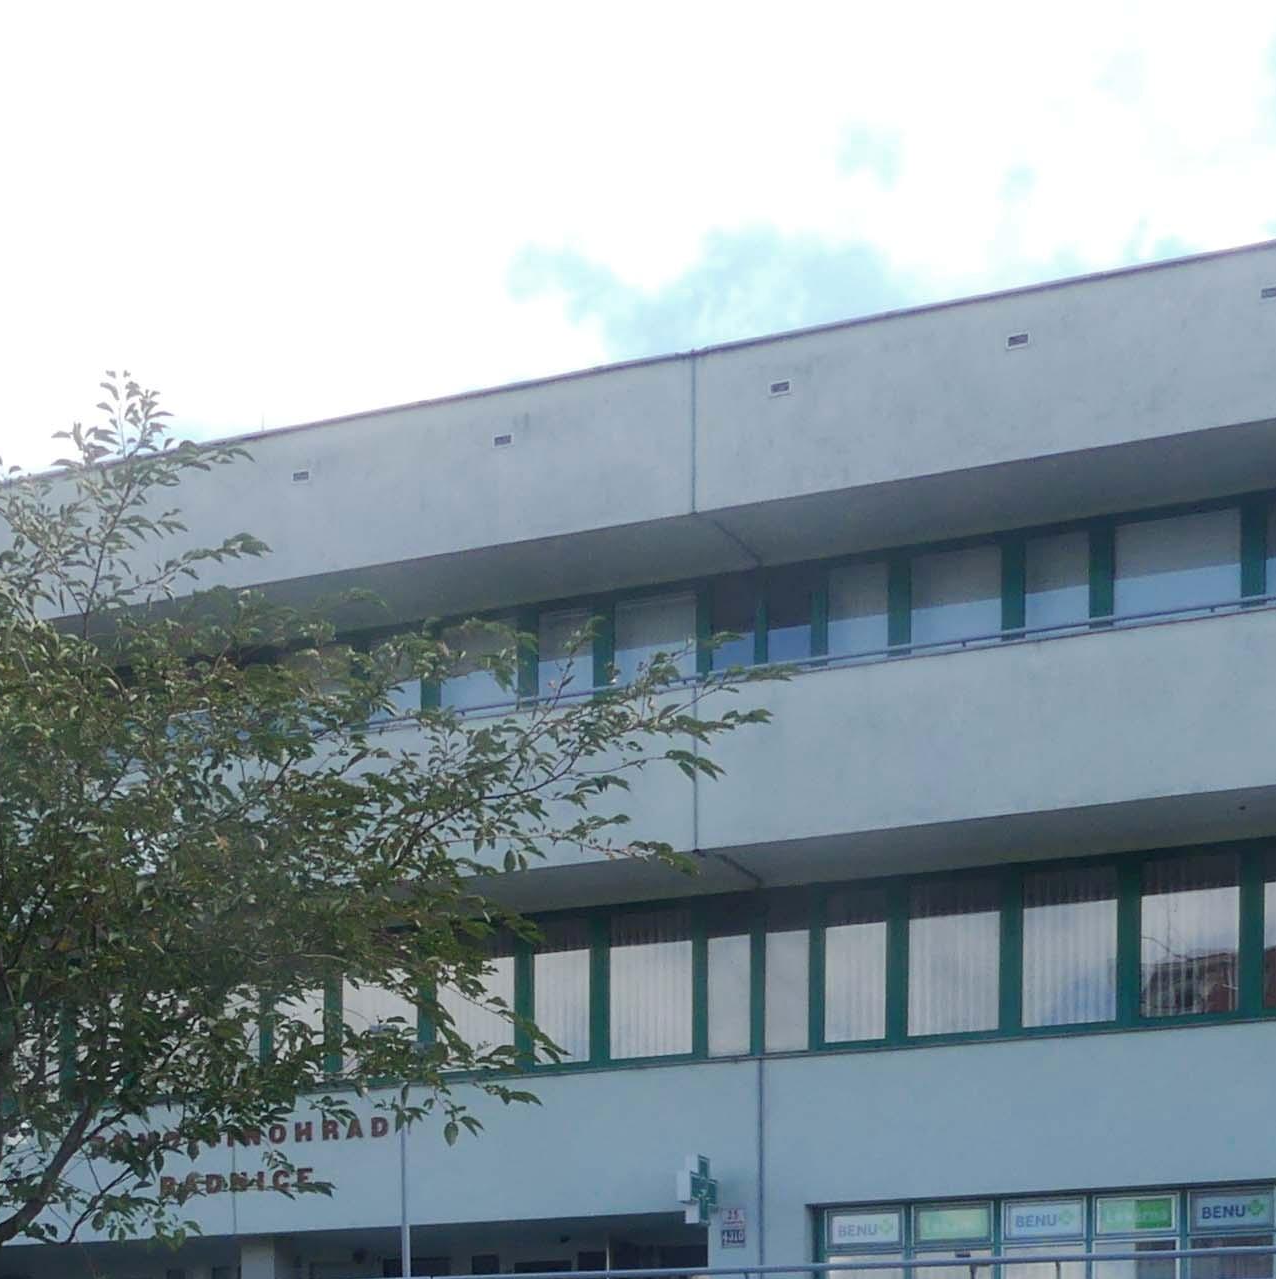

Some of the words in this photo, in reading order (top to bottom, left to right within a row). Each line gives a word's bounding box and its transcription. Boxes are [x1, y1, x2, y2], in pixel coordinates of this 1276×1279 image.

[1202, 1204, 1245, 1220] BENU
[1015, 1213, 1057, 1228] BENU
[837, 1223, 878, 1239] BENU
